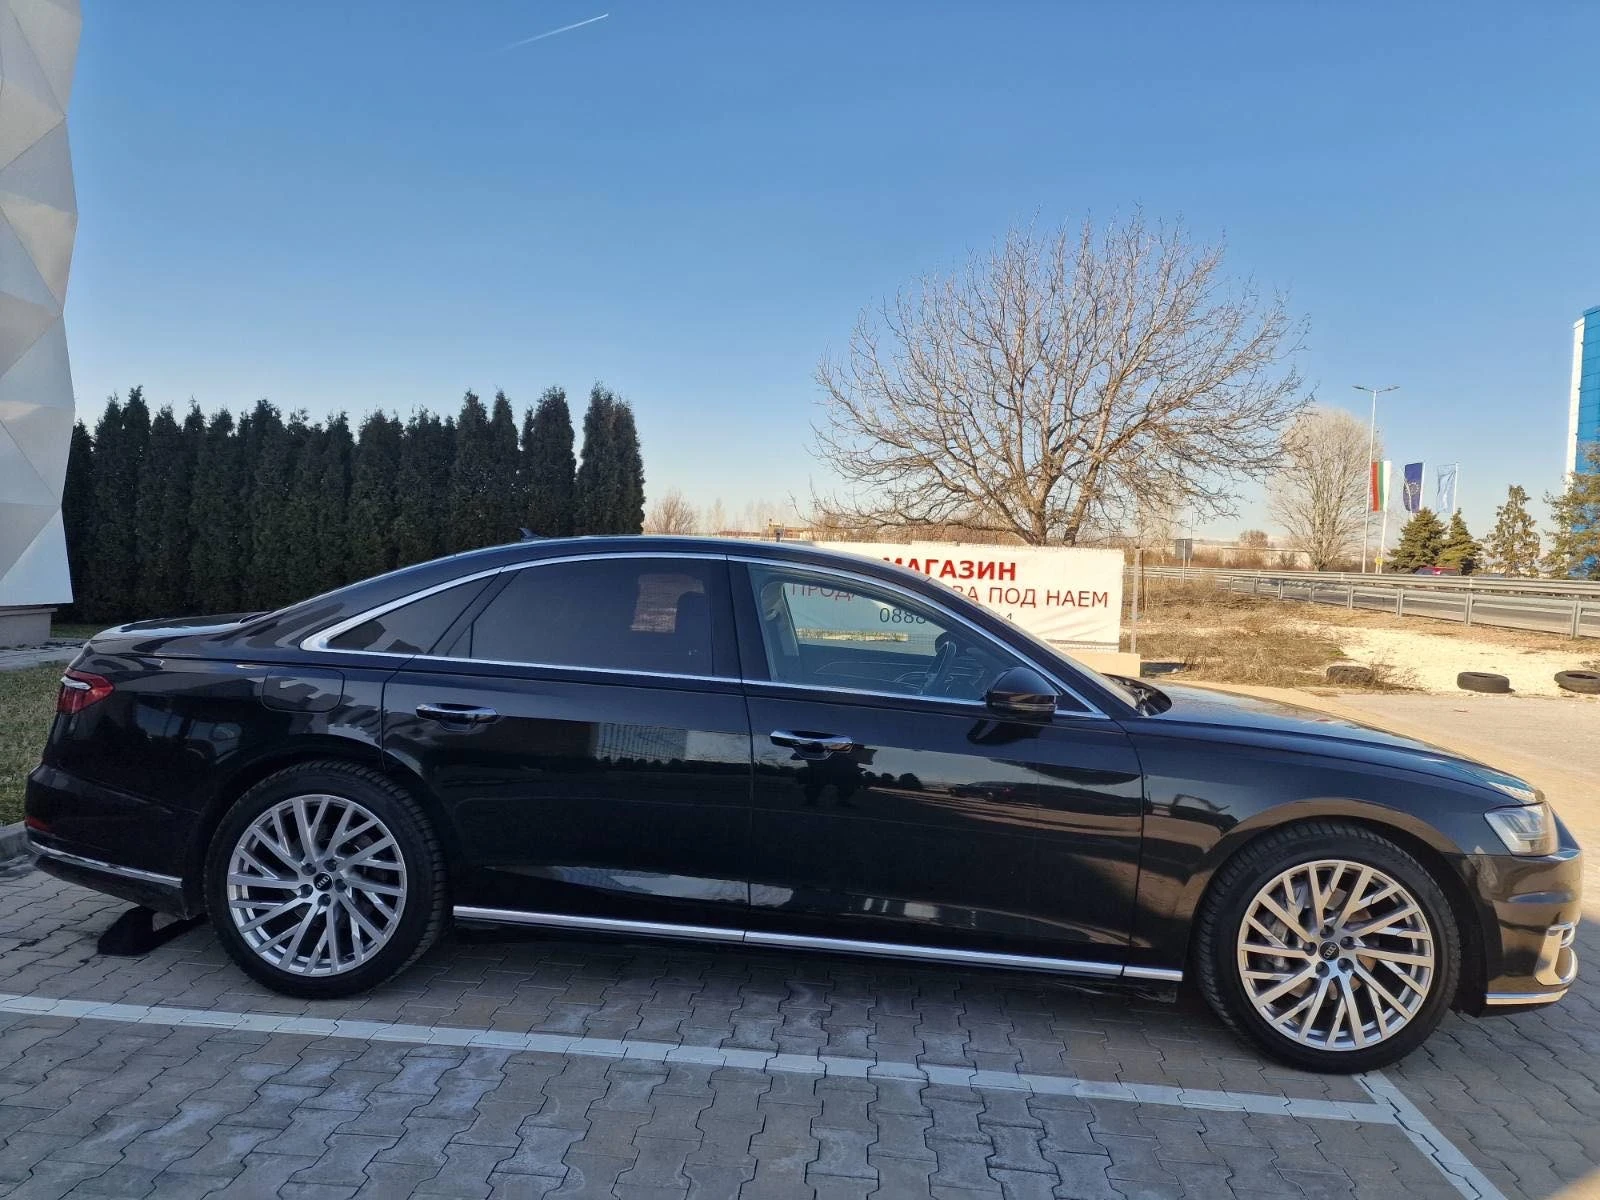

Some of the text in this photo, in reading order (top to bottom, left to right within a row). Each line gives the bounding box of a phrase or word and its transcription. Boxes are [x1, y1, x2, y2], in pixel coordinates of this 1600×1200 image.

[883, 557, 1016, 580] АГАЗИН
[988, 587, 1036, 608] ПОД
[1046, 590, 1109, 608] НАЕМ
